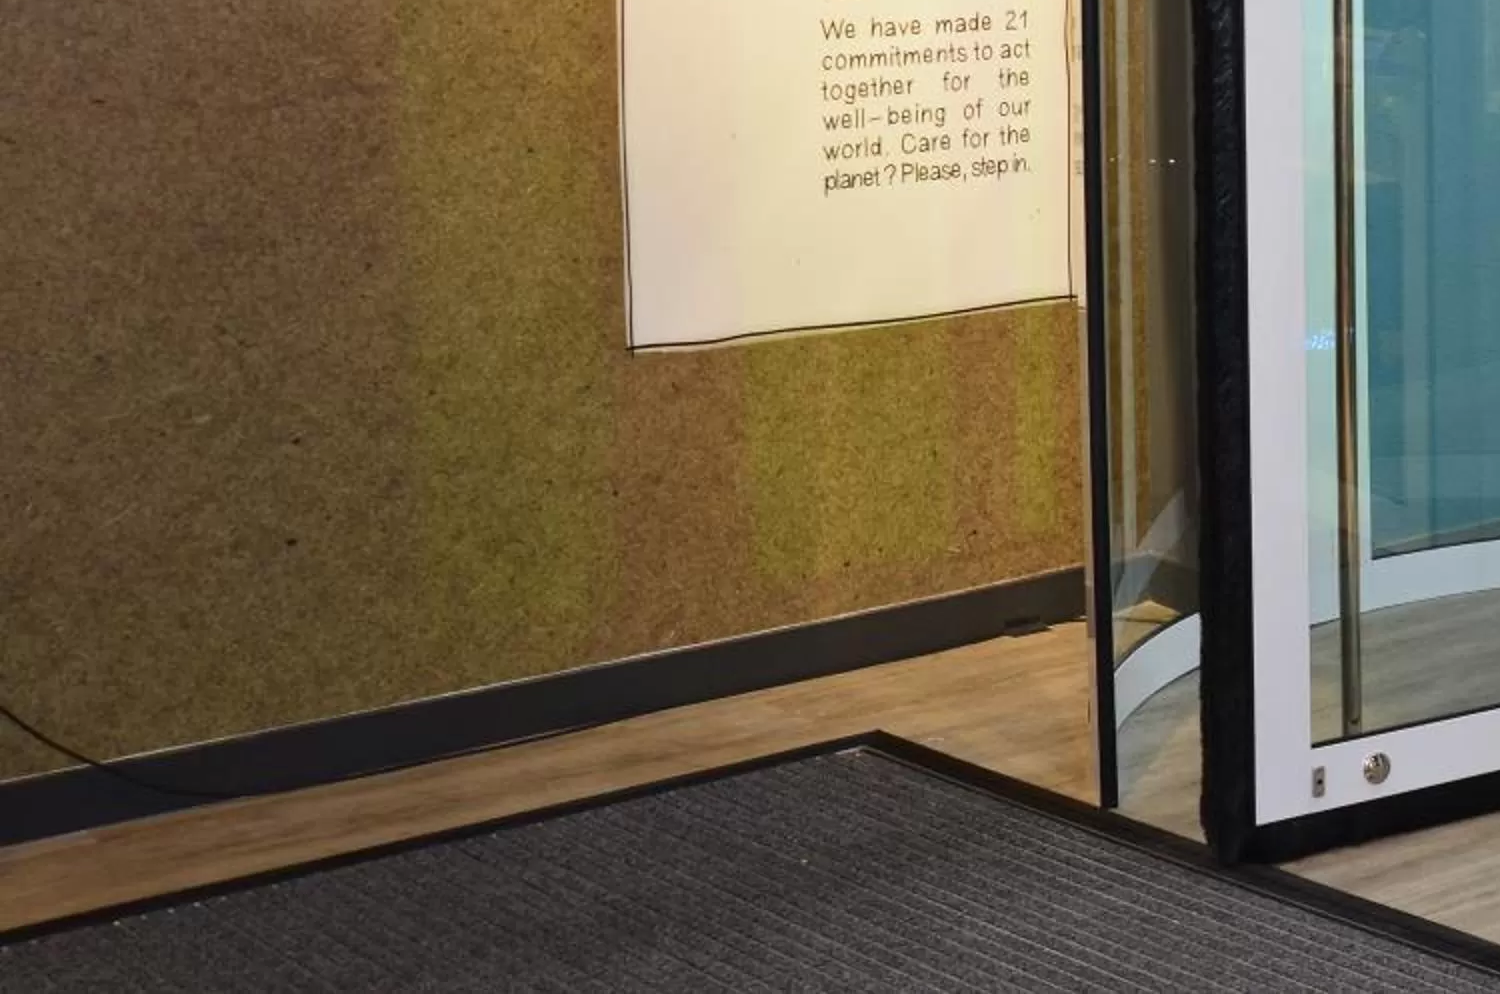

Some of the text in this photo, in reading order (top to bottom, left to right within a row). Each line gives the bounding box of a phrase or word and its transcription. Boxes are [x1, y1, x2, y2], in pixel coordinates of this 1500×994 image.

[821, 10, 1028, 40] We have made 21
[822, 40, 1030, 71] commitments to act
[822, 68, 1029, 104] together for the
[823, 98, 1031, 131] well-being of our
[823, 125, 1030, 161] world. Care for the
[901, 161, 967, 184] Please,
[971, 157, 1009, 180] step
